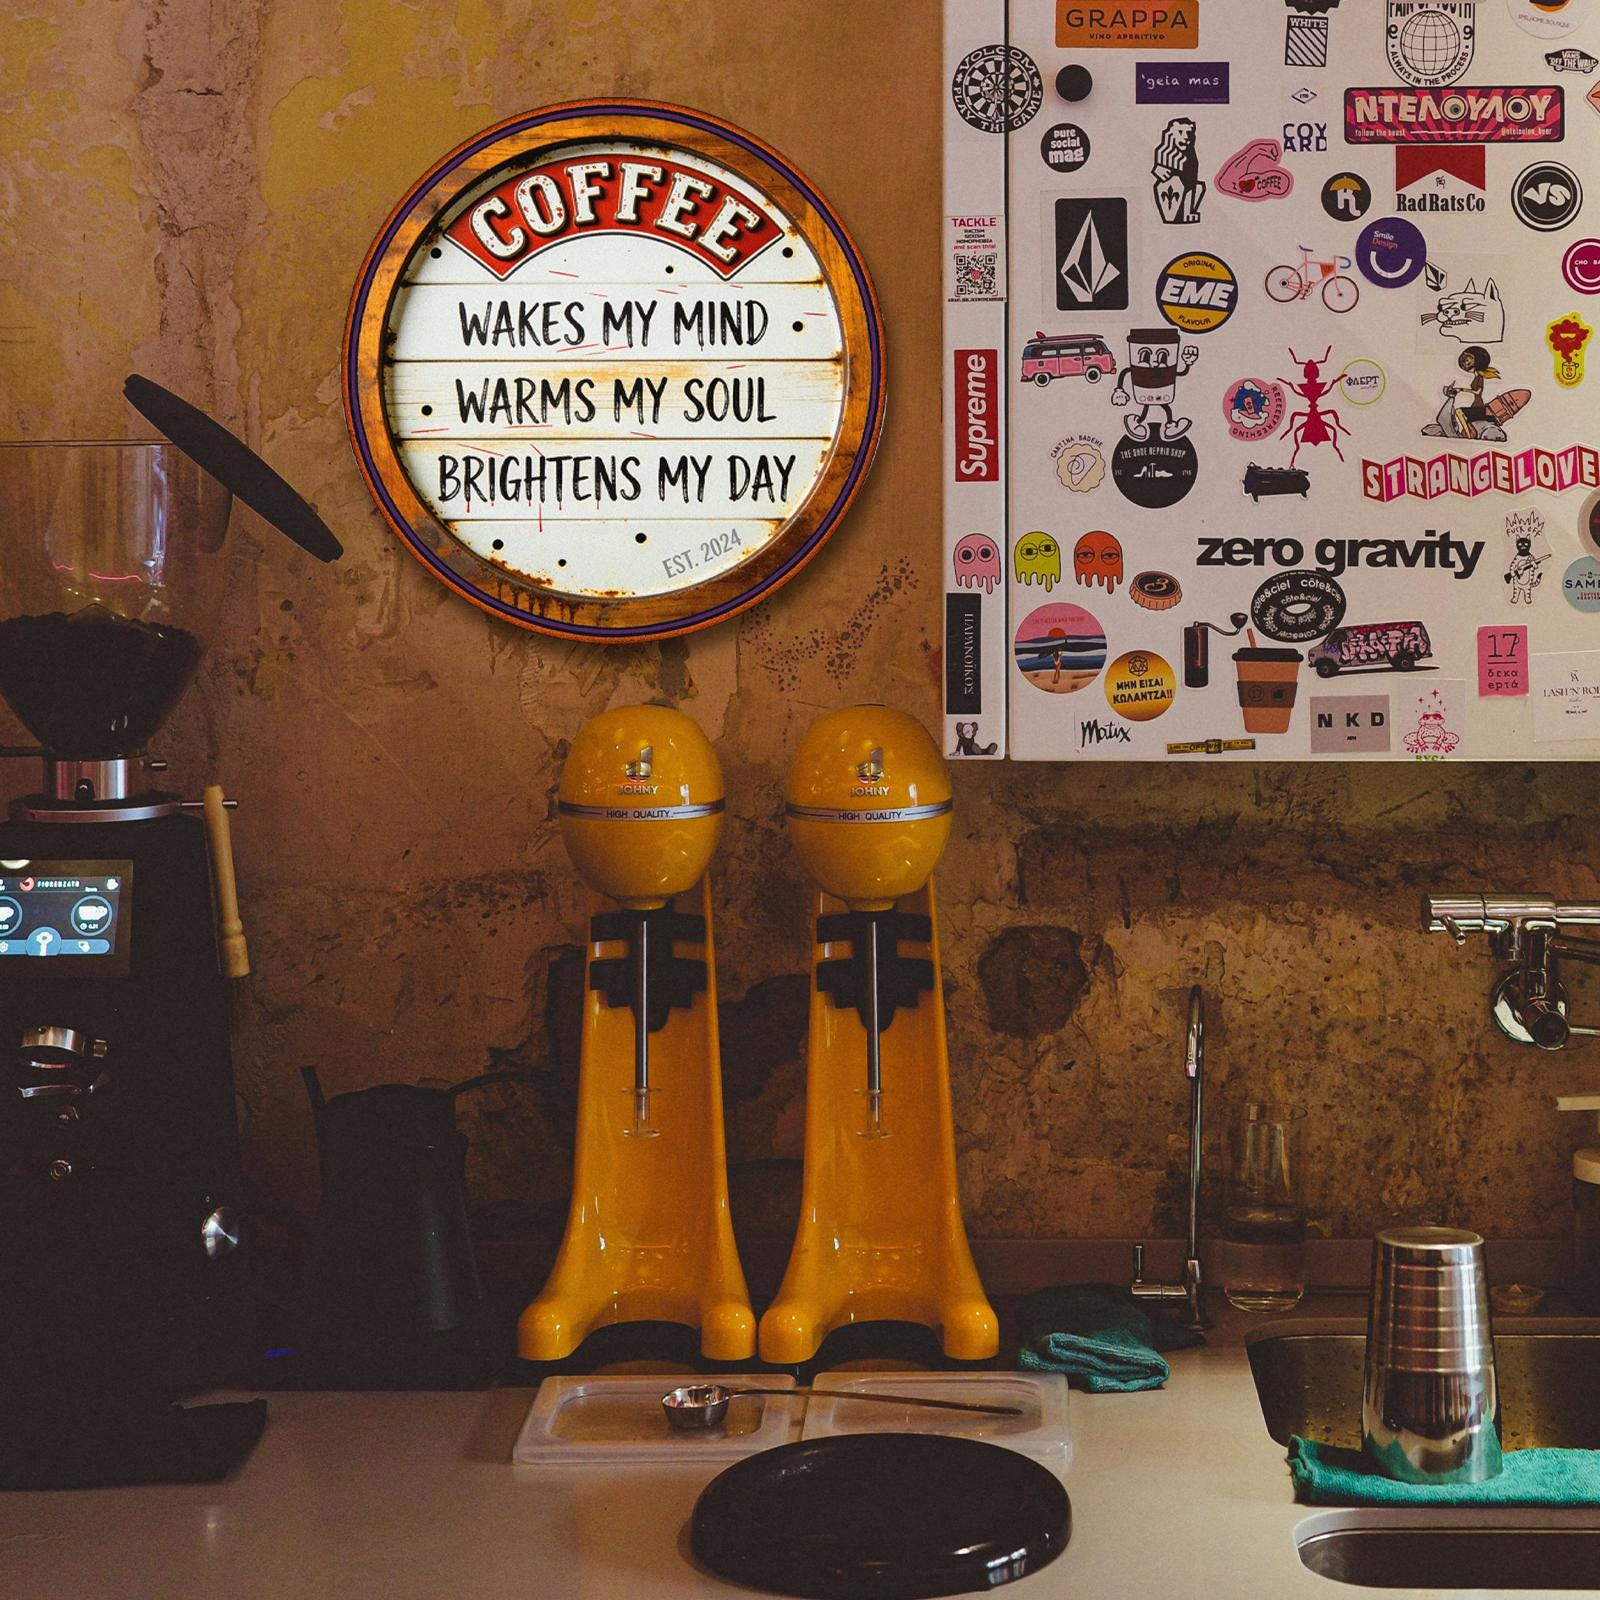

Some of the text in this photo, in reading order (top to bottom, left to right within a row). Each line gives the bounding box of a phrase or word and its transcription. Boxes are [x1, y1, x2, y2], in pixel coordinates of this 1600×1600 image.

[1066, 9, 1188, 28] GRAPPA
[1290, 18, 1327, 28] WHITE
[960, 46, 1036, 75] VOLCOM
[1391, 51, 1412, 80] ALWAYS
[1413, 76, 1421, 84] IN
[1441, 52, 1469, 82] PROCESS
[1189, 77, 1219, 86] mas
[954, 87, 976, 120] PLAY
[1013, 90, 1041, 127] GAME
[1053, 129, 1076, 139] pure
[1283, 122, 1327, 139] COY
[1355, 129, 1374, 137] follow
[1050, 137, 1081, 149] social
[1283, 136, 1327, 152] ARD
[1048, 147, 1085, 164] mag
[1257, 175, 1282, 190] COFFEE
[469, 160, 762, 266] COFFEE
[952, 217, 997, 227] TACKLE
[1373, 230, 1395, 241] Smile
[1372, 238, 1398, 250] Design
[1183, 260, 1216, 271] ORIGINAL
[1160, 277, 1235, 309] EME
[459, 300, 768, 348] WAKES MY MIND
[1178, 314, 1211, 326] FLAVOUR
[455, 376, 777, 427] WARMS MY SOUL
[960, 354, 994, 477] Supreme
[437, 454, 797, 504] BRIGHTENS MY DAY
[1366, 451, 1599, 497] STRANGELOVE
[1506, 526, 1525, 537] FUCK
[662, 528, 742, 579] EST. 2024
[1197, 529, 1486, 580] zero gravity
[1565, 579, 1600, 588] SAM
[1487, 633, 1518, 658] 17
[1116, 678, 1164, 691] ΜΗΝ ΕΙΣΑΙ
[1081, 719, 1131, 748] Matix
[617, 785, 659, 796] JOHNY
[849, 786, 890, 798] JOHNY
[606, 809, 671, 819] HIGH QUALITY
[838, 811, 902, 821] HIGH QUALITY
[37, 880, 80, 888] FIORENZATO
